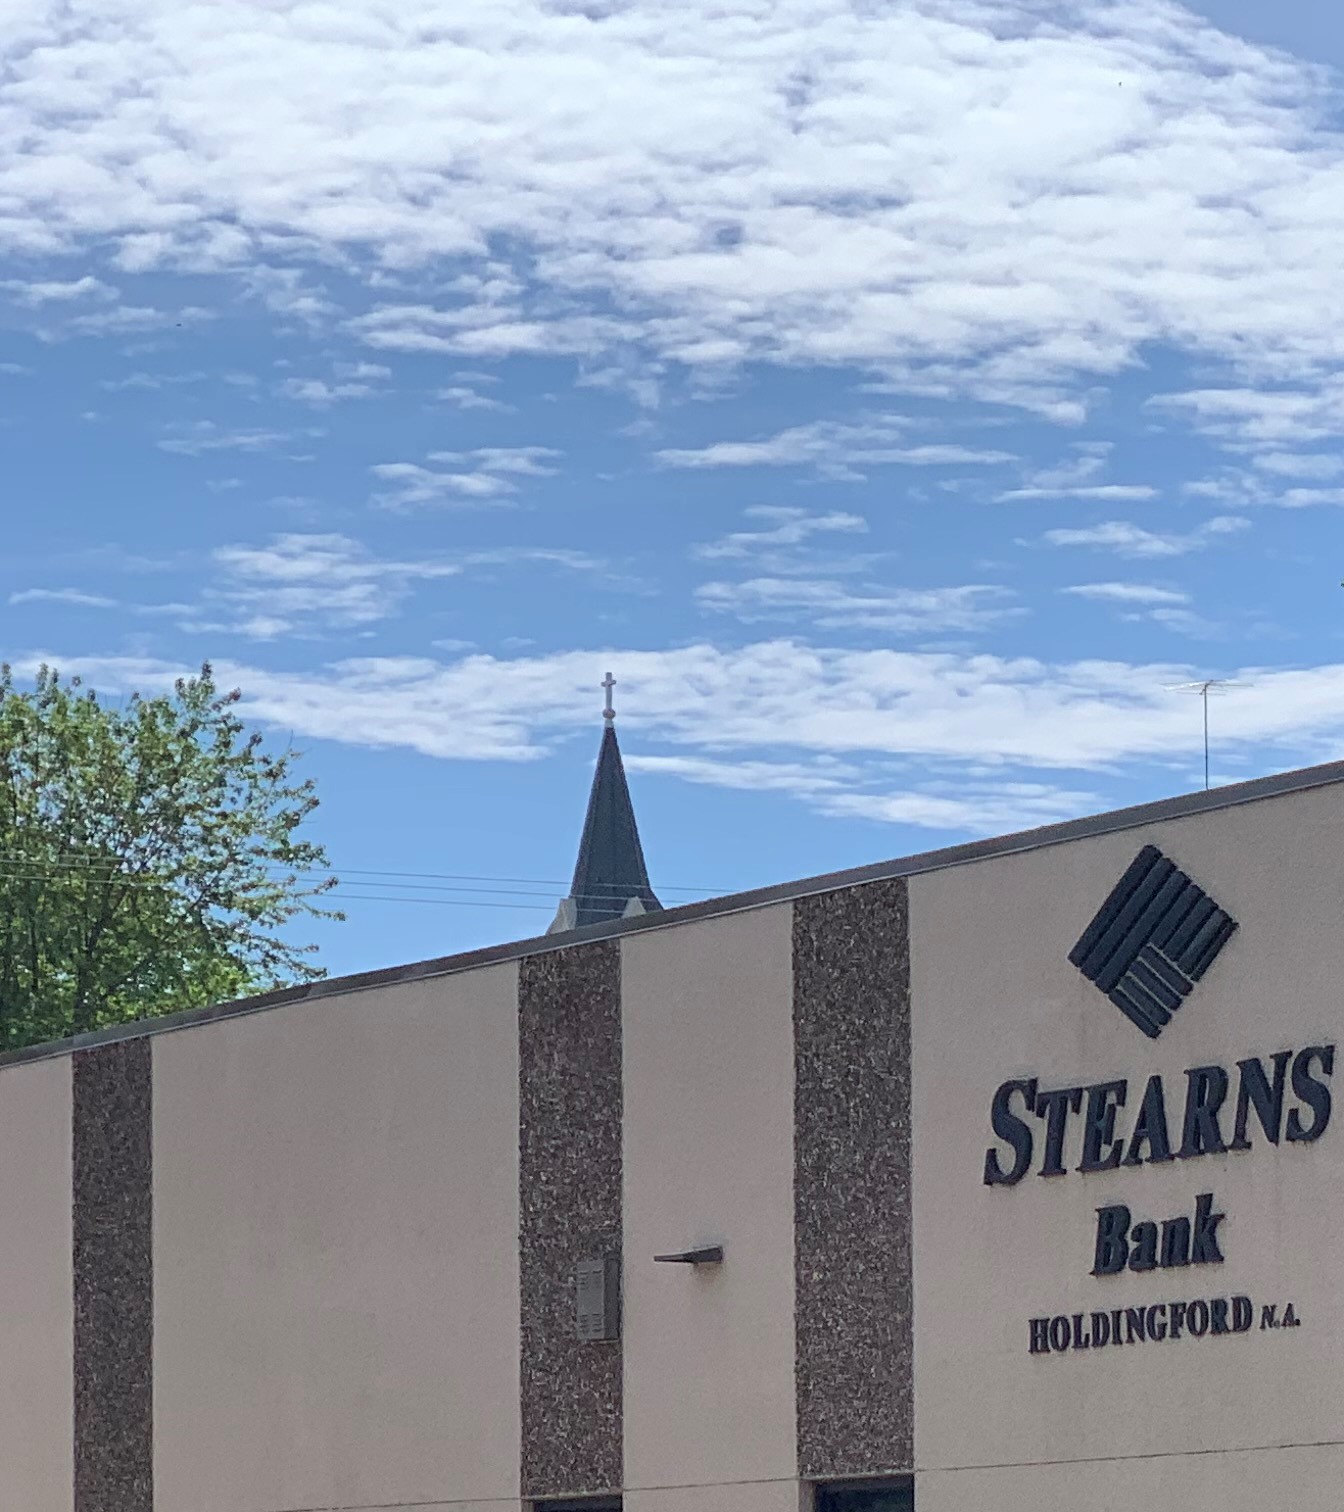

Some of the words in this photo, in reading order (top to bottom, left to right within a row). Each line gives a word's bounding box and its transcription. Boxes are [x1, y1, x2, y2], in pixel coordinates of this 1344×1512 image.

[983, 1043, 1336, 1185] STEARNS
[1089, 1193, 1225, 1277] Bank
[1027, 1296, 1254, 1354] HOLDINGFORD
[1259, 1303, 1301, 1329] N.A.
